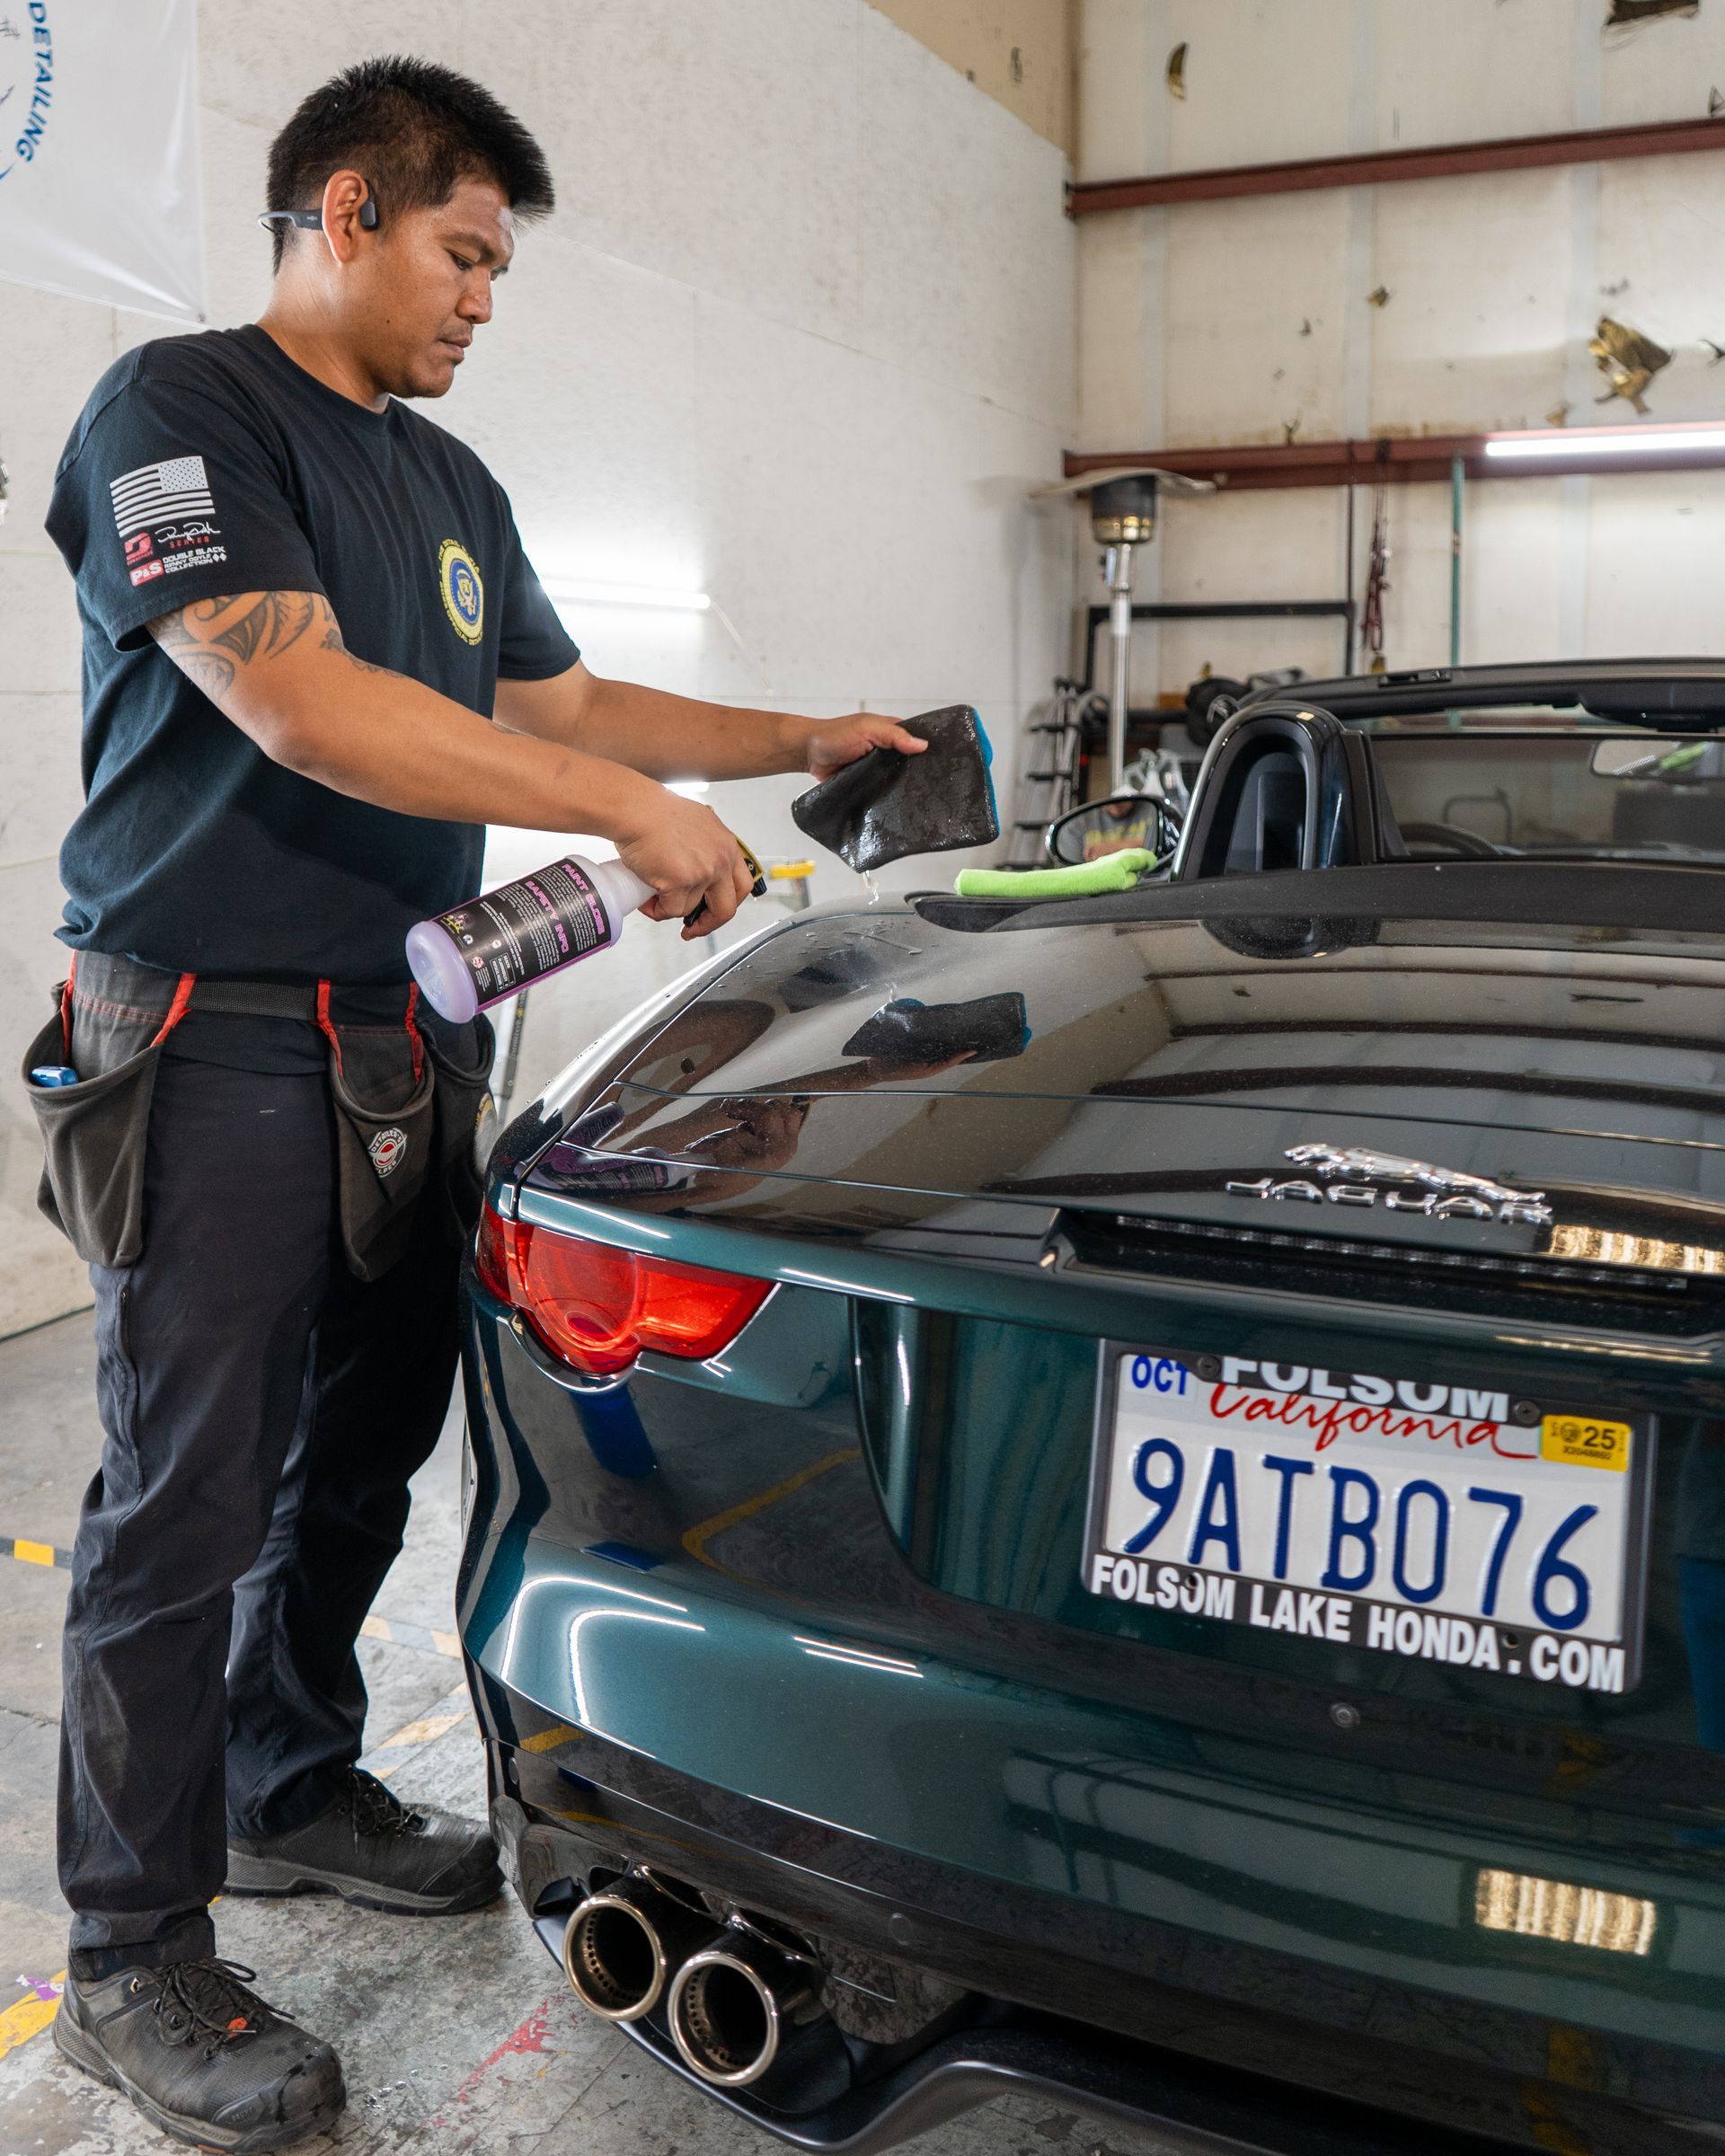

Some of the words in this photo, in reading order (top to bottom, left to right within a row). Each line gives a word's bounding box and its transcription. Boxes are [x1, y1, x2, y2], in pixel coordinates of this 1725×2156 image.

[15, 2, 53, 162] DETAILING
[130, 561, 162, 584] P&S
[163, 550, 194, 564] DOUBLE
[195, 546, 226, 557] BLACK
[164, 558, 213, 574] COLLECTION
[562, 863, 588, 890] PAINT
[525, 880, 560, 921] SAFETY
[554, 923, 570, 953] INFO
[371, 1129, 402, 1152] DETAILER'S
[1225, 1177, 1552, 1224] JAGUAR
[1132, 1355, 1189, 1395] OCT
[1221, 1356, 1508, 1423] FOLSOM
[1210, 1383, 1538, 1459] California
[1583, 1426, 1615, 1450] 25
[1123, 1437, 1598, 1631] 9ATB076
[1091, 1554, 1236, 1620] FOLSOM
[1249, 1584, 1353, 1642] LAKE
